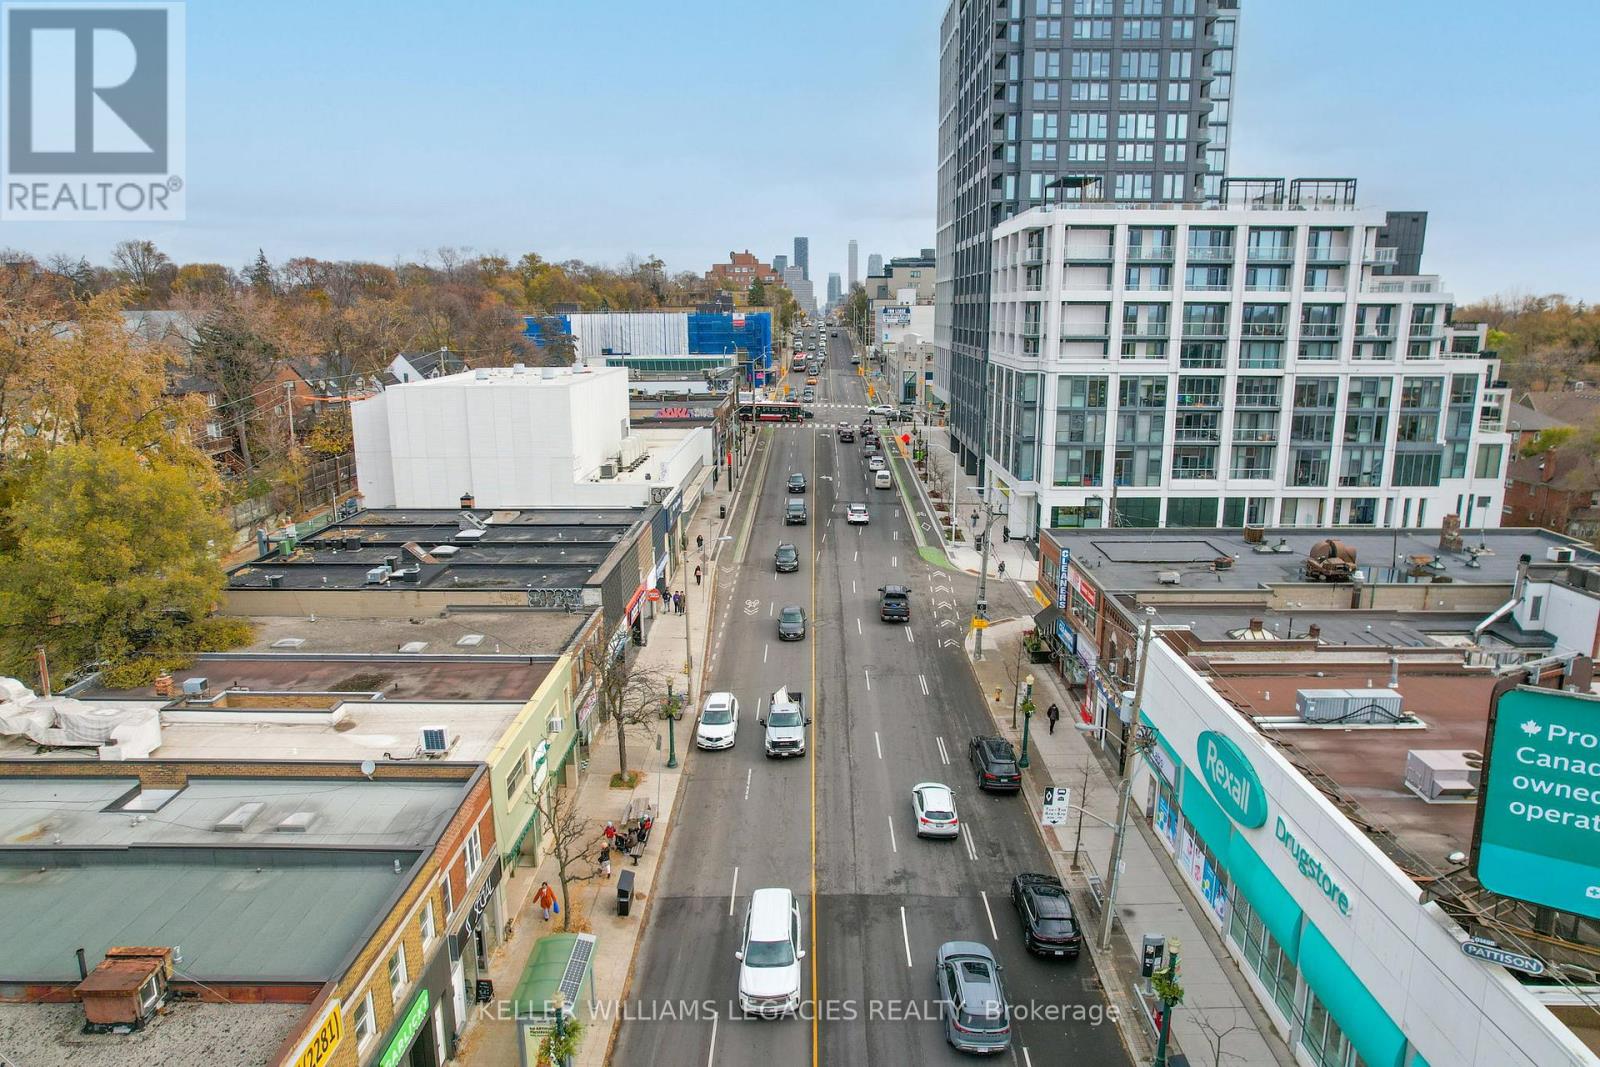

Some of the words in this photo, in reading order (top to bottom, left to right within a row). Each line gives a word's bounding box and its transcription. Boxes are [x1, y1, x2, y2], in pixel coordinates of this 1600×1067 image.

[1058, 549, 1069, 609] CLEANERS
[1547, 723, 1598, 748] Pro
[1206, 739, 1250, 815] Rexall
[1275, 815, 1349, 916] Drugstore
[1468, 945, 1537, 971] PATTISON
